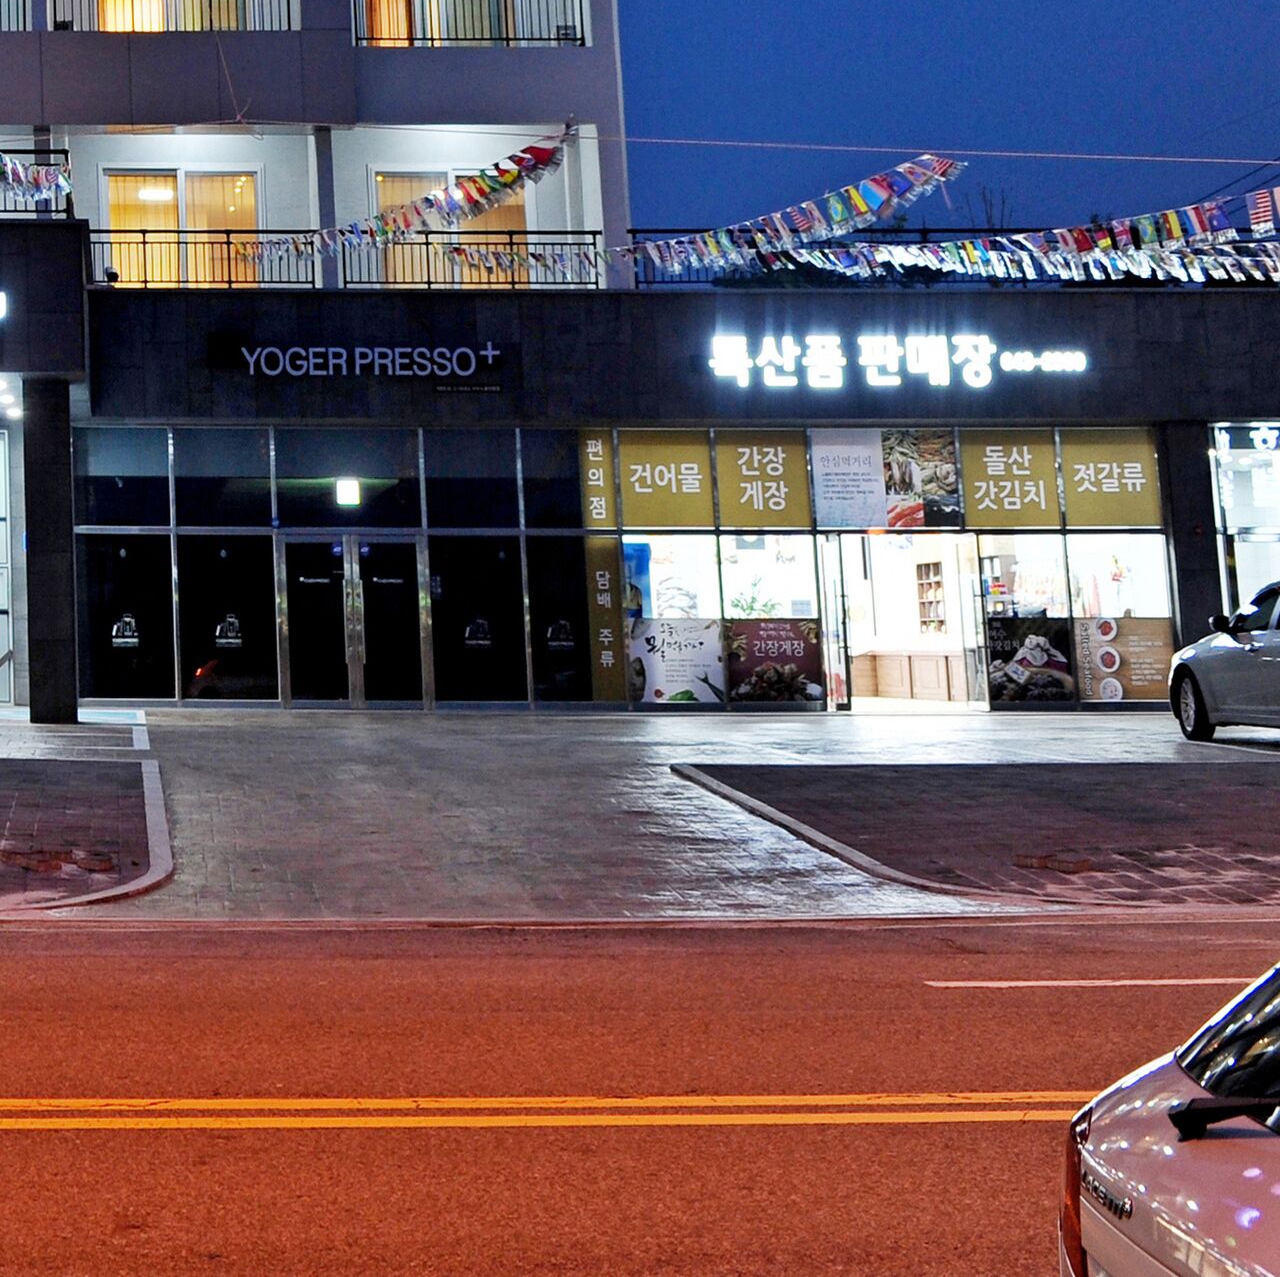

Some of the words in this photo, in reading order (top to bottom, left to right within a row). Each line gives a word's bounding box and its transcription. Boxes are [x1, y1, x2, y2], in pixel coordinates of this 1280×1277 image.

[241, 346, 347, 377] YOGER
[709, 335, 848, 388] 특산품
[857, 335, 997, 388] 판매장
[737, 446, 787, 477] 간장
[983, 445, 1033, 476] 돌산
[585, 438, 608, 520] 편의점
[629, 462, 703, 494] 건어물
[1073, 462, 1147, 494] 젓갈류
[740, 480, 788, 511] 게장
[974, 479, 1047, 511] 갓김치
[595, 570, 613, 609] 담배
[597, 627, 616, 668] 주류
[753, 639, 806, 657] 간장게장
